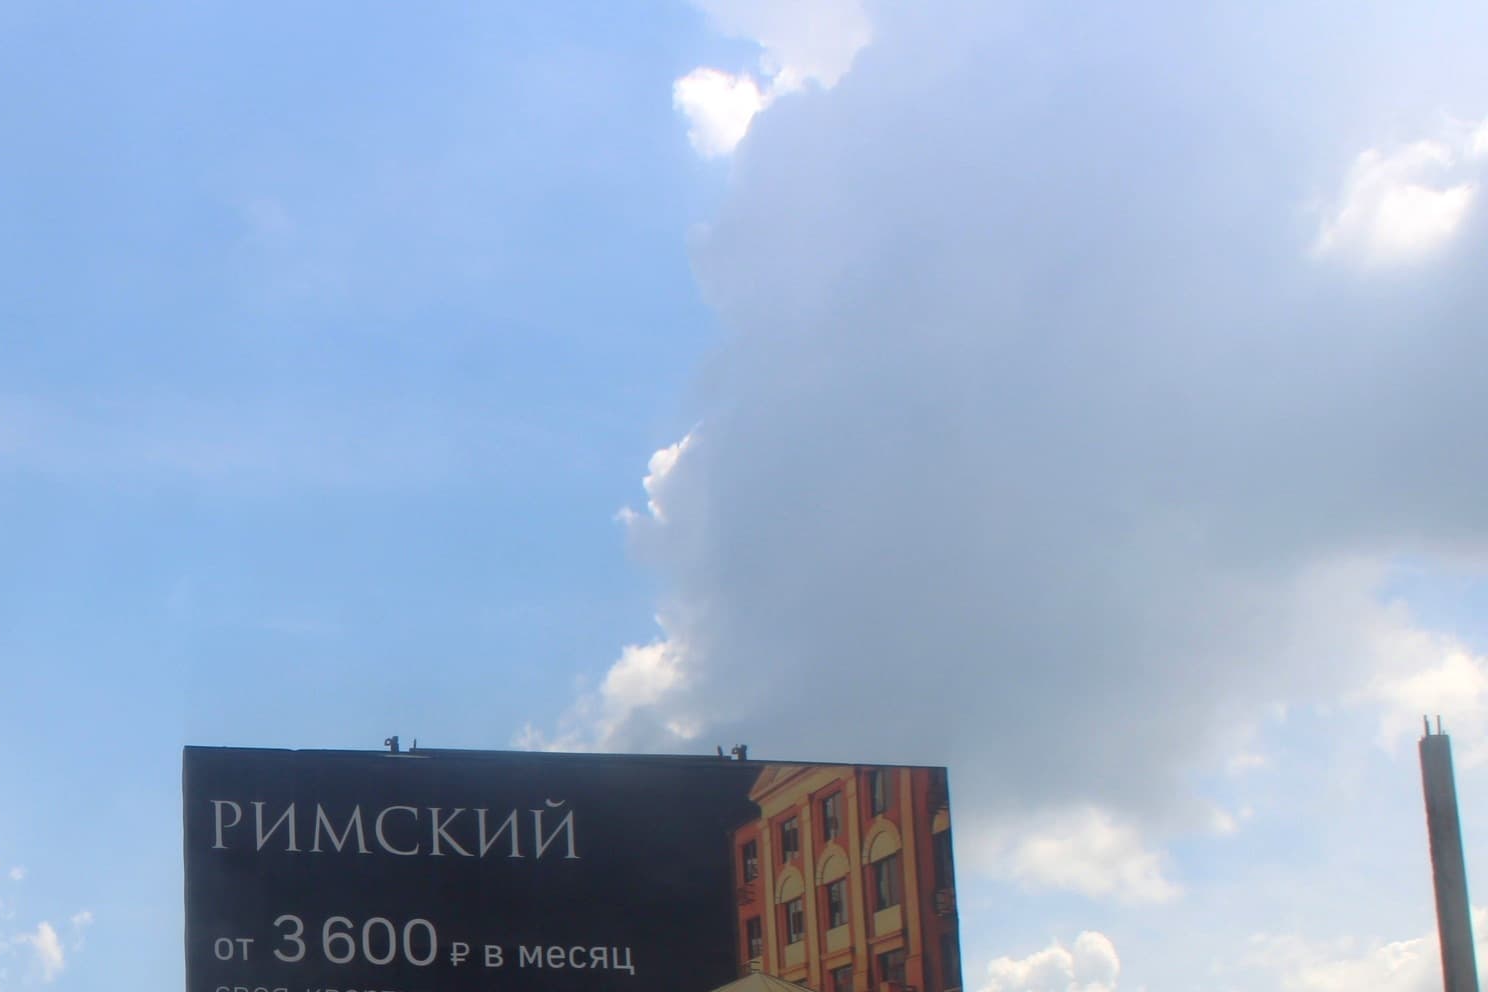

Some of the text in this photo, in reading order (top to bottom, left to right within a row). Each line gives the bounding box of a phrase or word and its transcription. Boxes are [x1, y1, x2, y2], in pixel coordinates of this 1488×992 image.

[210, 797, 582, 860] РИМСКИЙ
[214, 937, 254, 961] от
[484, 944, 504, 968] в
[519, 945, 635, 976] месяц
